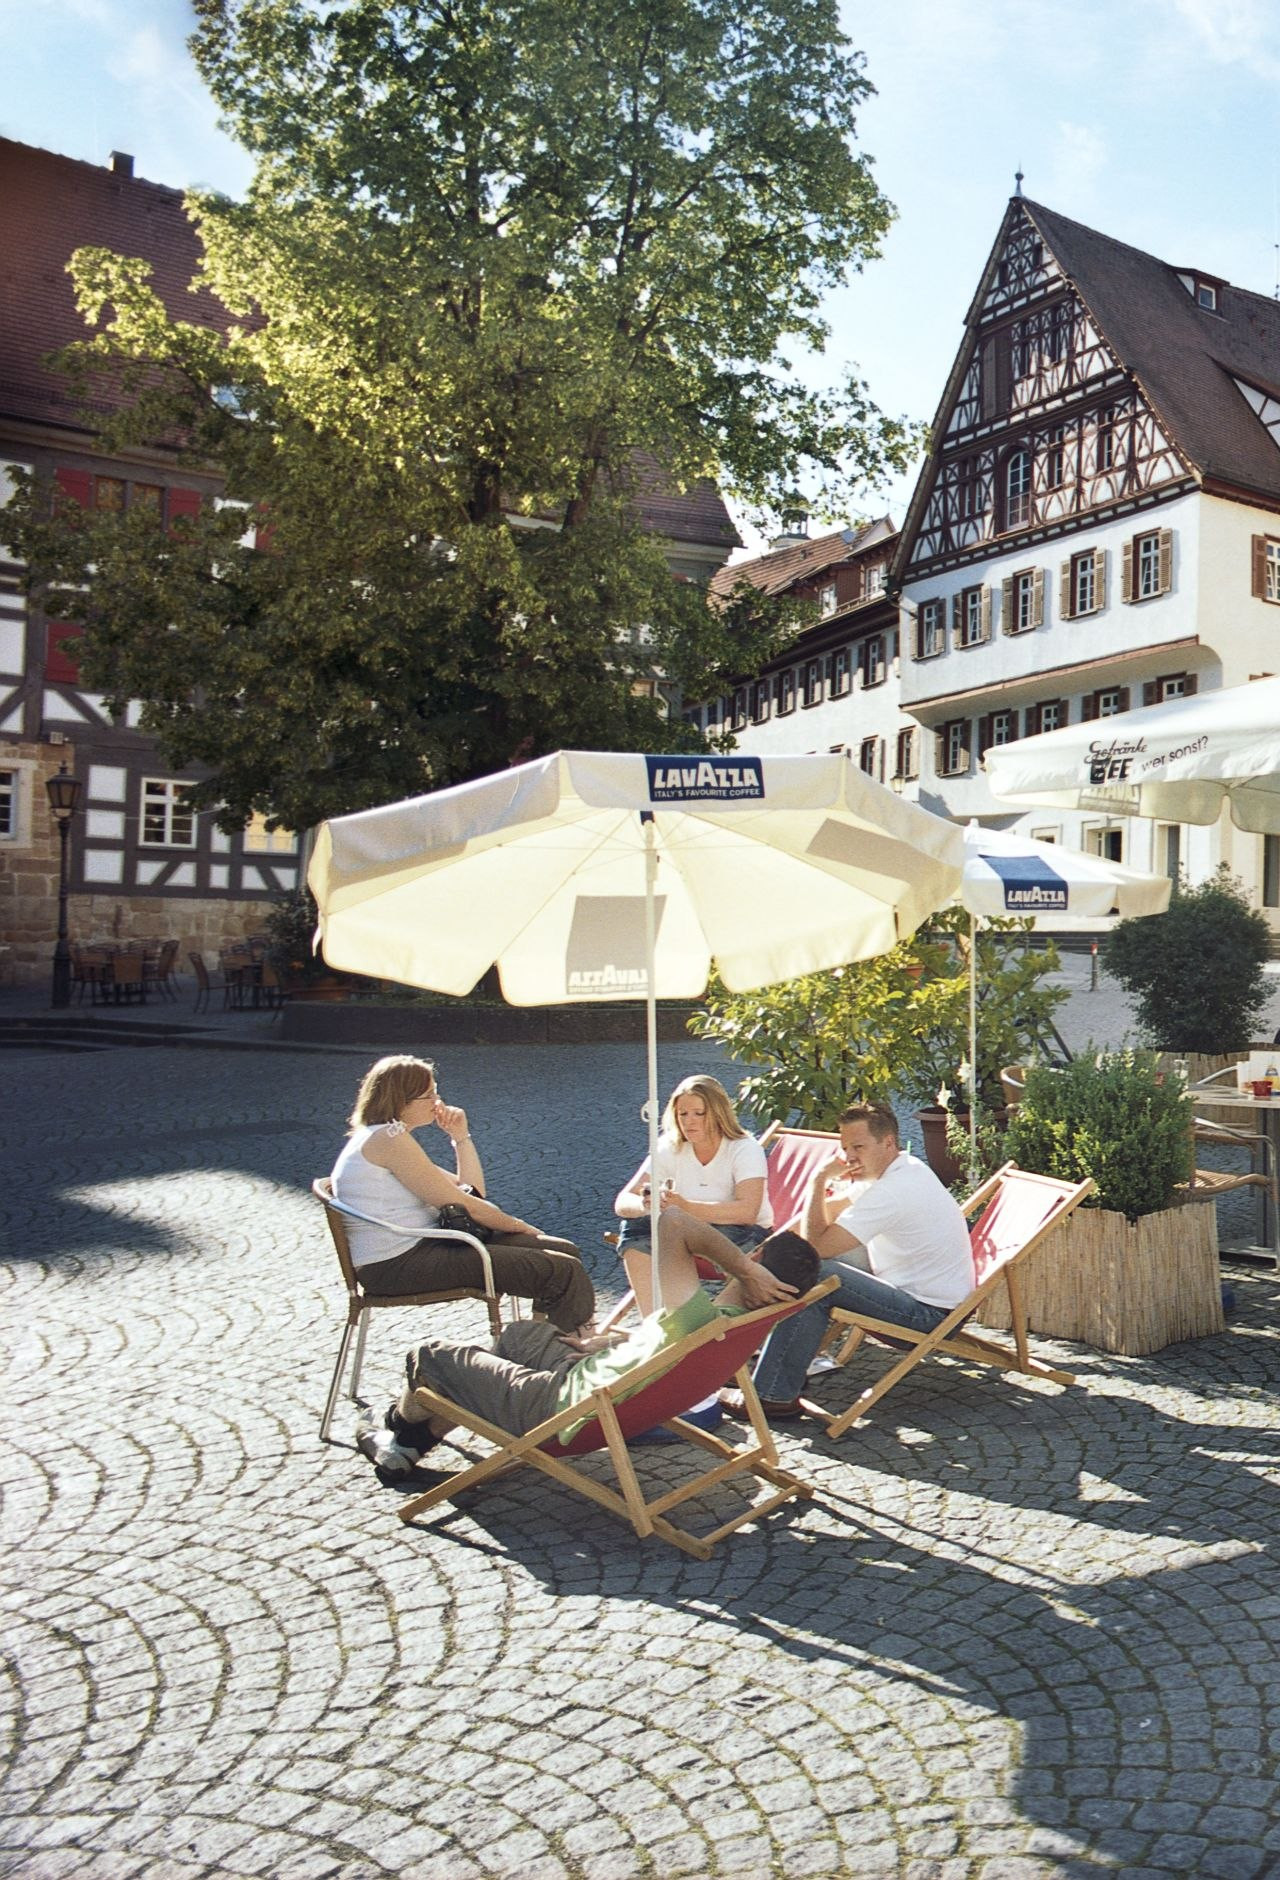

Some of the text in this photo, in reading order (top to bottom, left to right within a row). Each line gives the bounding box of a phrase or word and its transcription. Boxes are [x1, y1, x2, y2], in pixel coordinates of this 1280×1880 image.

[1141, 735, 1209, 772] wer sonst?
[653, 761, 760, 789] LAVAZZA
[1090, 758, 1134, 784] BEE
[653, 788, 760, 798] ITALY'S FAVOURITE COFFEE
[1007, 886, 1066, 903] LAVAZZA
